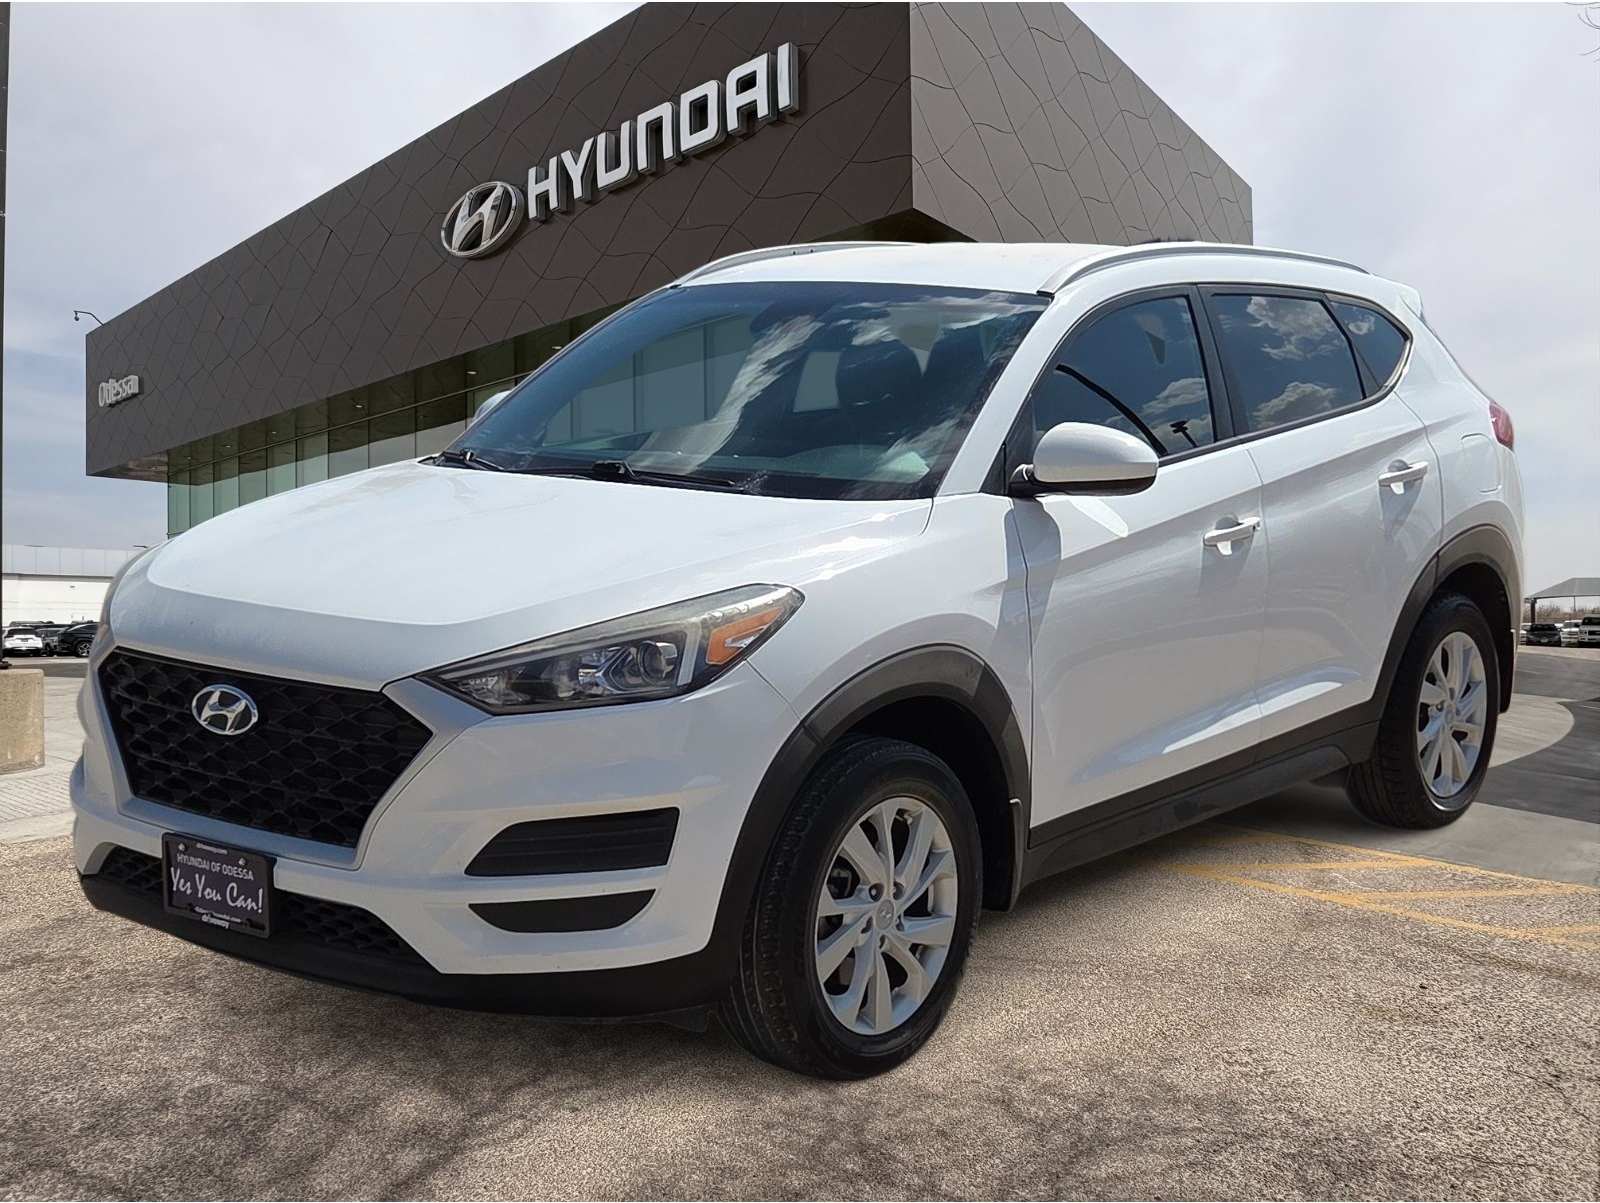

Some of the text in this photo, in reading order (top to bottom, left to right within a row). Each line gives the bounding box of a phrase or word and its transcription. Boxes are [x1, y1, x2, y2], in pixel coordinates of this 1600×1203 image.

[527, 41, 800, 221] HYUNDAI
[98, 374, 140, 408] Odessa
[176, 853, 254, 881] HYUNDAI OF ODESSA
[170, 866, 193, 895] Yes
[195, 873, 222, 901] You
[226, 882, 263, 914] Can!
